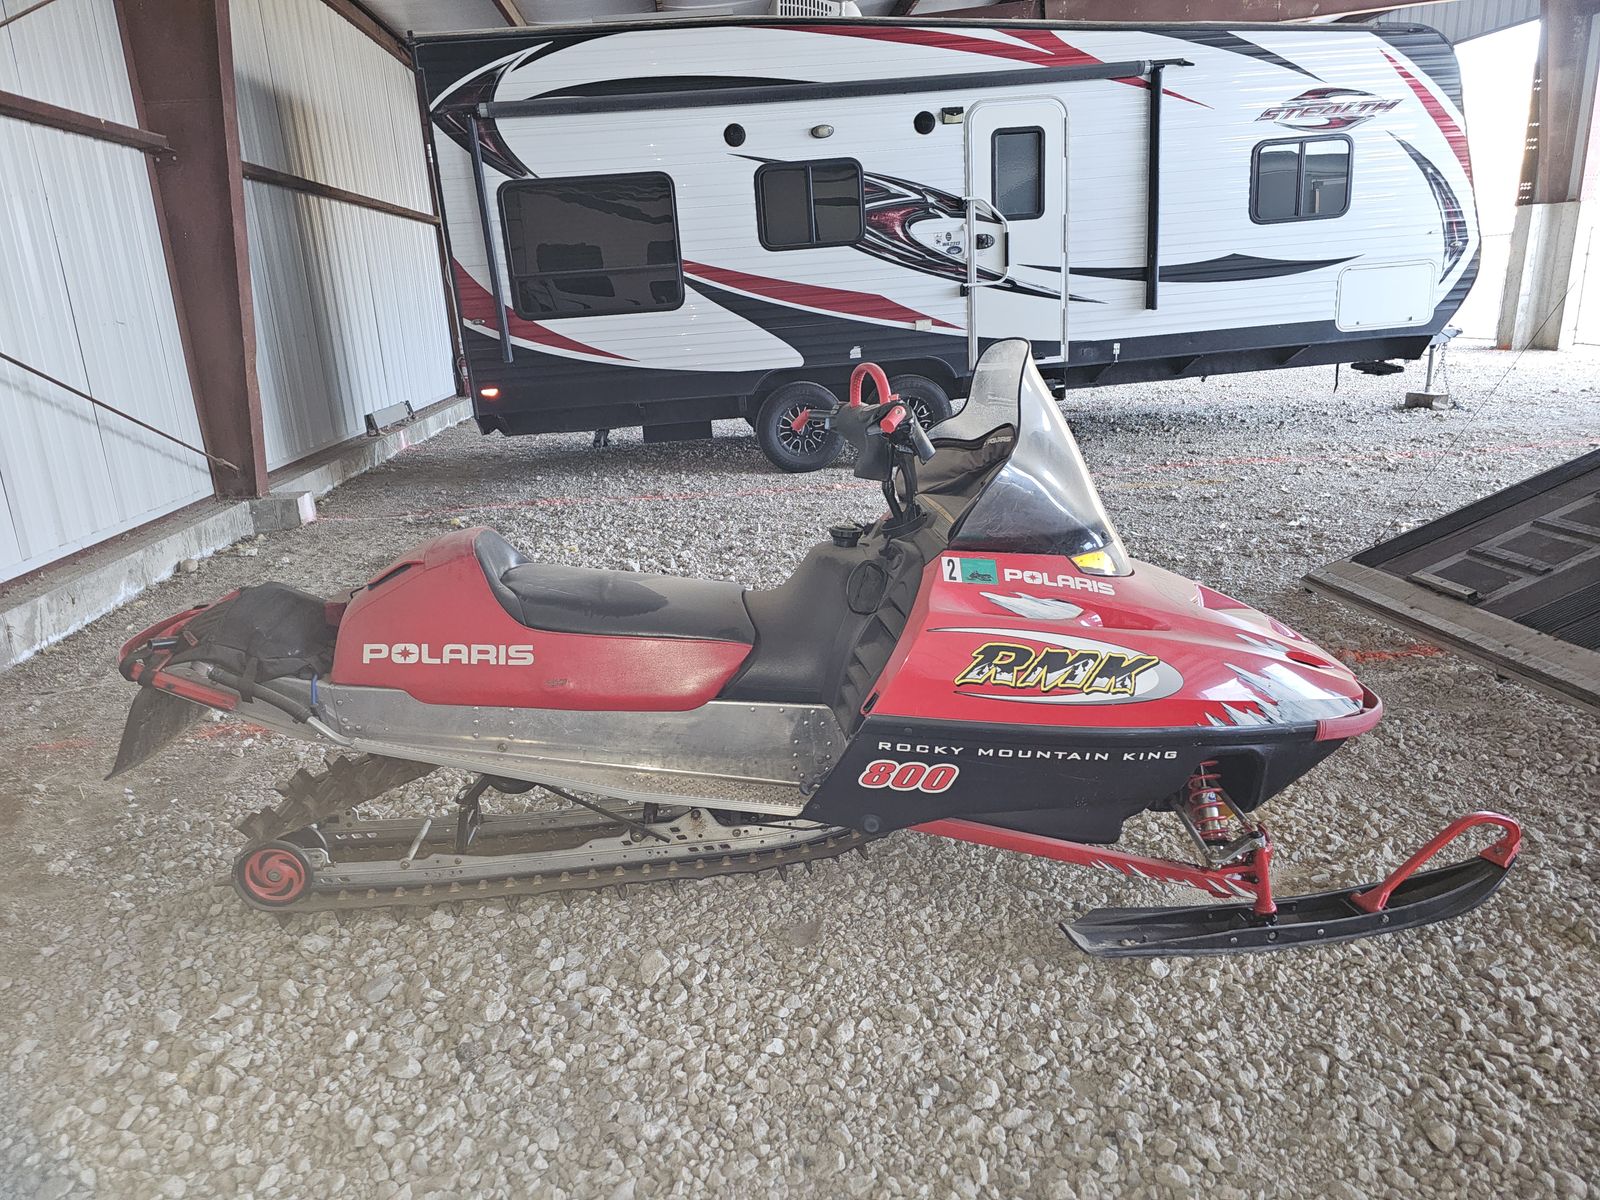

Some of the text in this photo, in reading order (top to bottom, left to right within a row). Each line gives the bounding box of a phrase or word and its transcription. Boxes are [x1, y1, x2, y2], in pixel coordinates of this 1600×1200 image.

[1255, 98, 1404, 122] STEALTH
[947, 558, 957, 581] 2
[1003, 568, 1116, 596] POLARIS
[362, 643, 535, 666] POLARIS
[953, 641, 1160, 696] RMK
[878, 741, 1179, 761] ROCKY MOUNTAIN KING
[858, 759, 960, 794] 800
